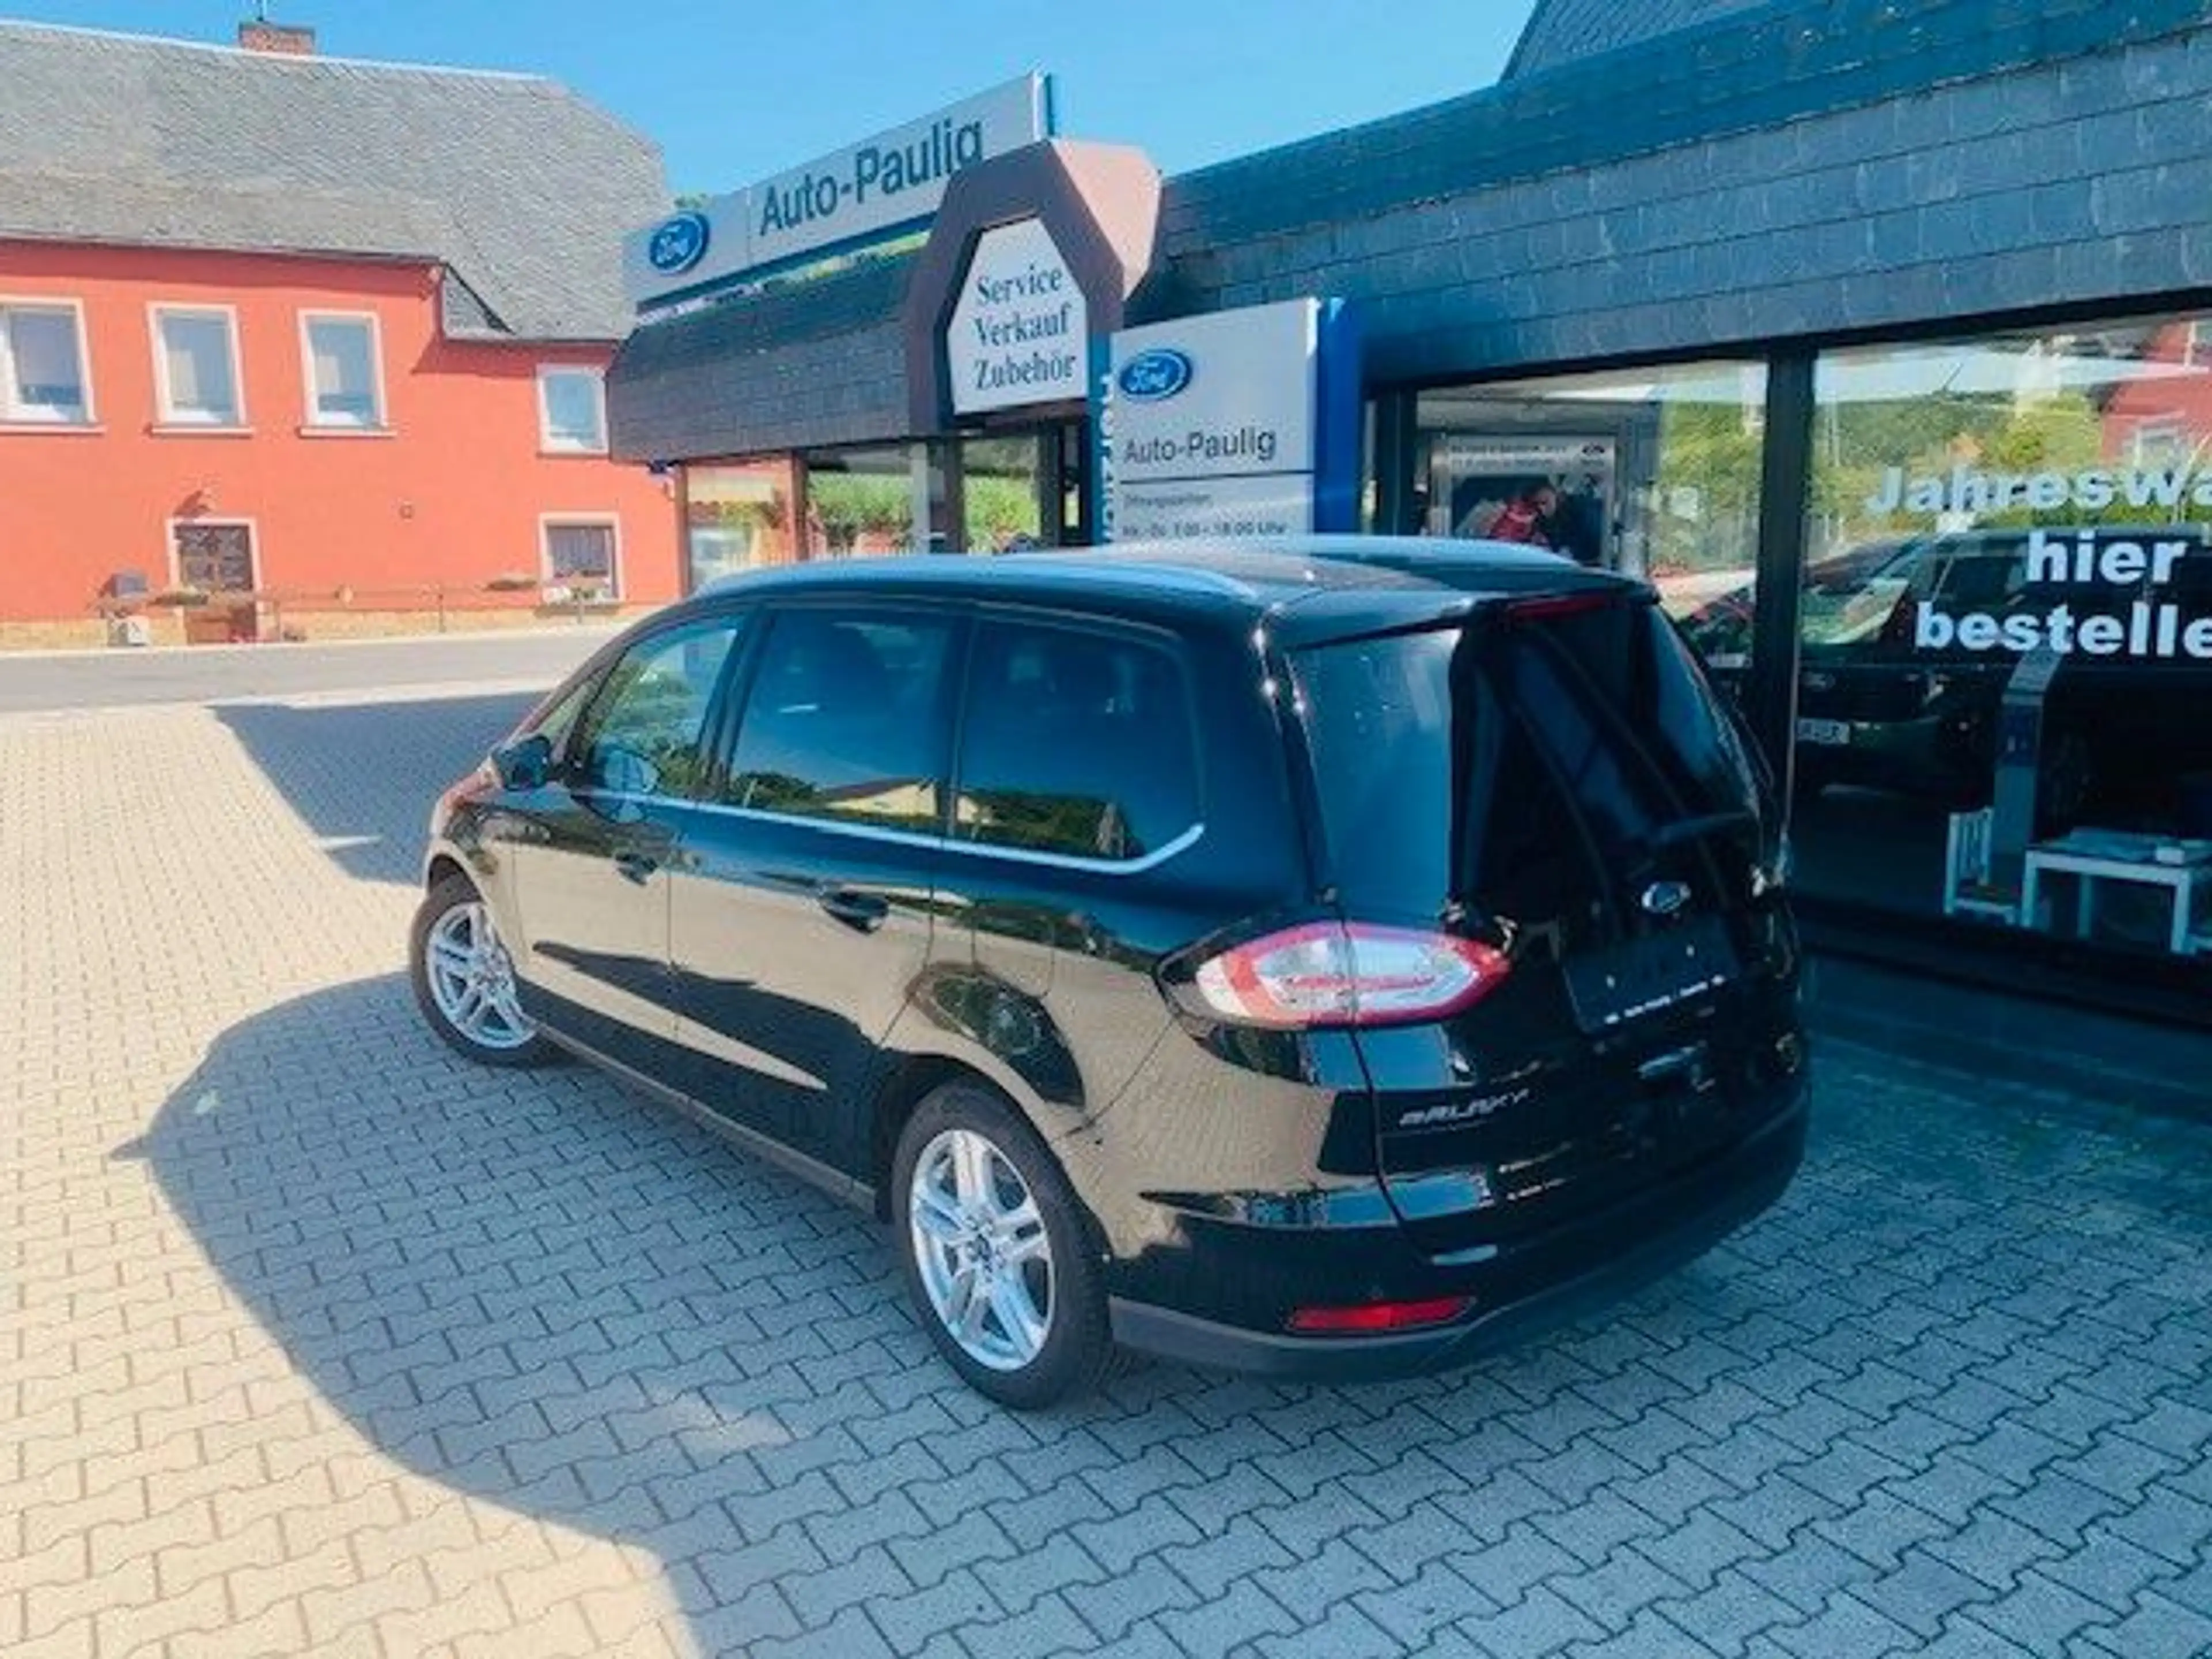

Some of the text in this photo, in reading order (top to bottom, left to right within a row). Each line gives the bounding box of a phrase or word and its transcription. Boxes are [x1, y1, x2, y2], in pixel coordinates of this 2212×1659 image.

[760, 119, 983, 236] Auto-Paulig
[976, 265, 1063, 306] Service
[973, 304, 1073, 348] Verkauf
[975, 349, 1077, 391] Zubehör
[1123, 428, 1277, 463] Auto-Paulig
[2027, 531, 2187, 584] hier
